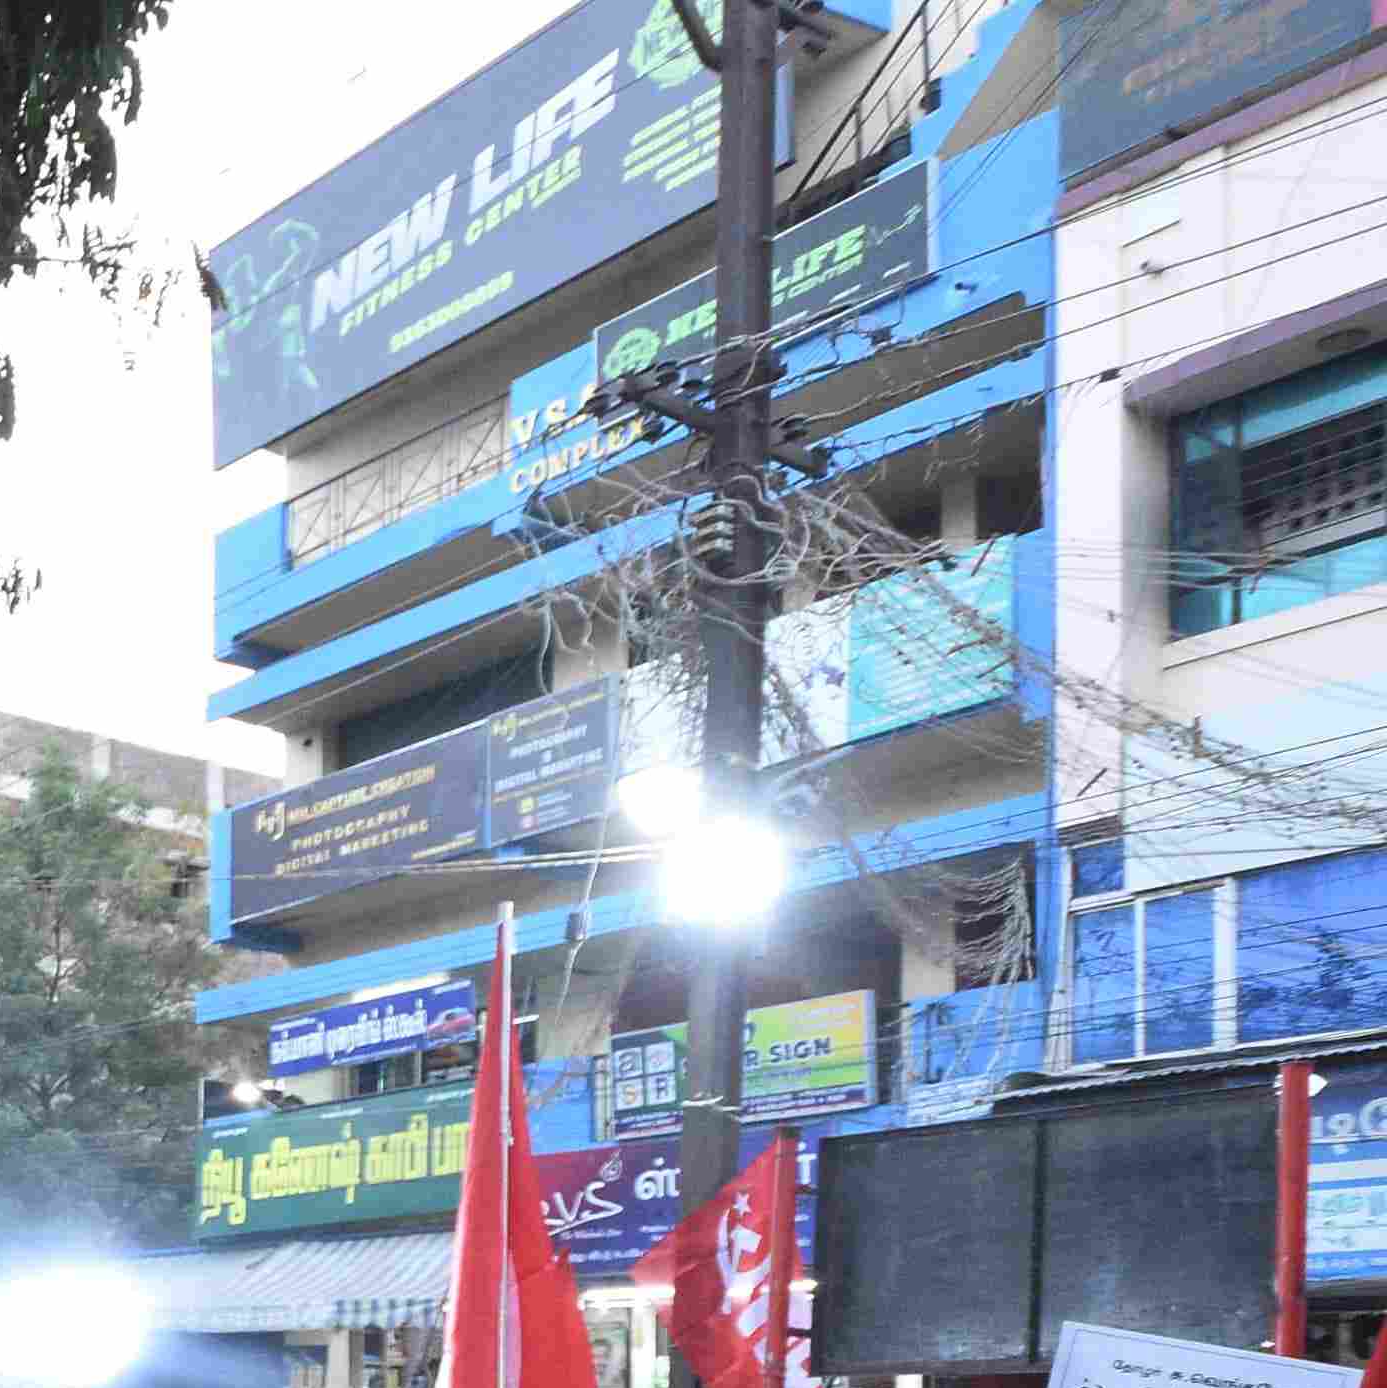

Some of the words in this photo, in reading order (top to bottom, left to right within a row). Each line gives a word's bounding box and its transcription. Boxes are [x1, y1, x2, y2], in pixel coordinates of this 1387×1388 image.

[309, 173, 457, 332] NEW
[469, 48, 619, 214] LIFE
[340, 241, 453, 337] FITNESS
[464, 144, 582, 247] CENTER
[666, 299, 718, 346] NE
[772, 225, 866, 292] LIFE
[292, 804, 411, 850] PHOTOGRAPHY
[339, 817, 429, 856] MARKETING
[768, 1037, 832, 1065] SIGN
